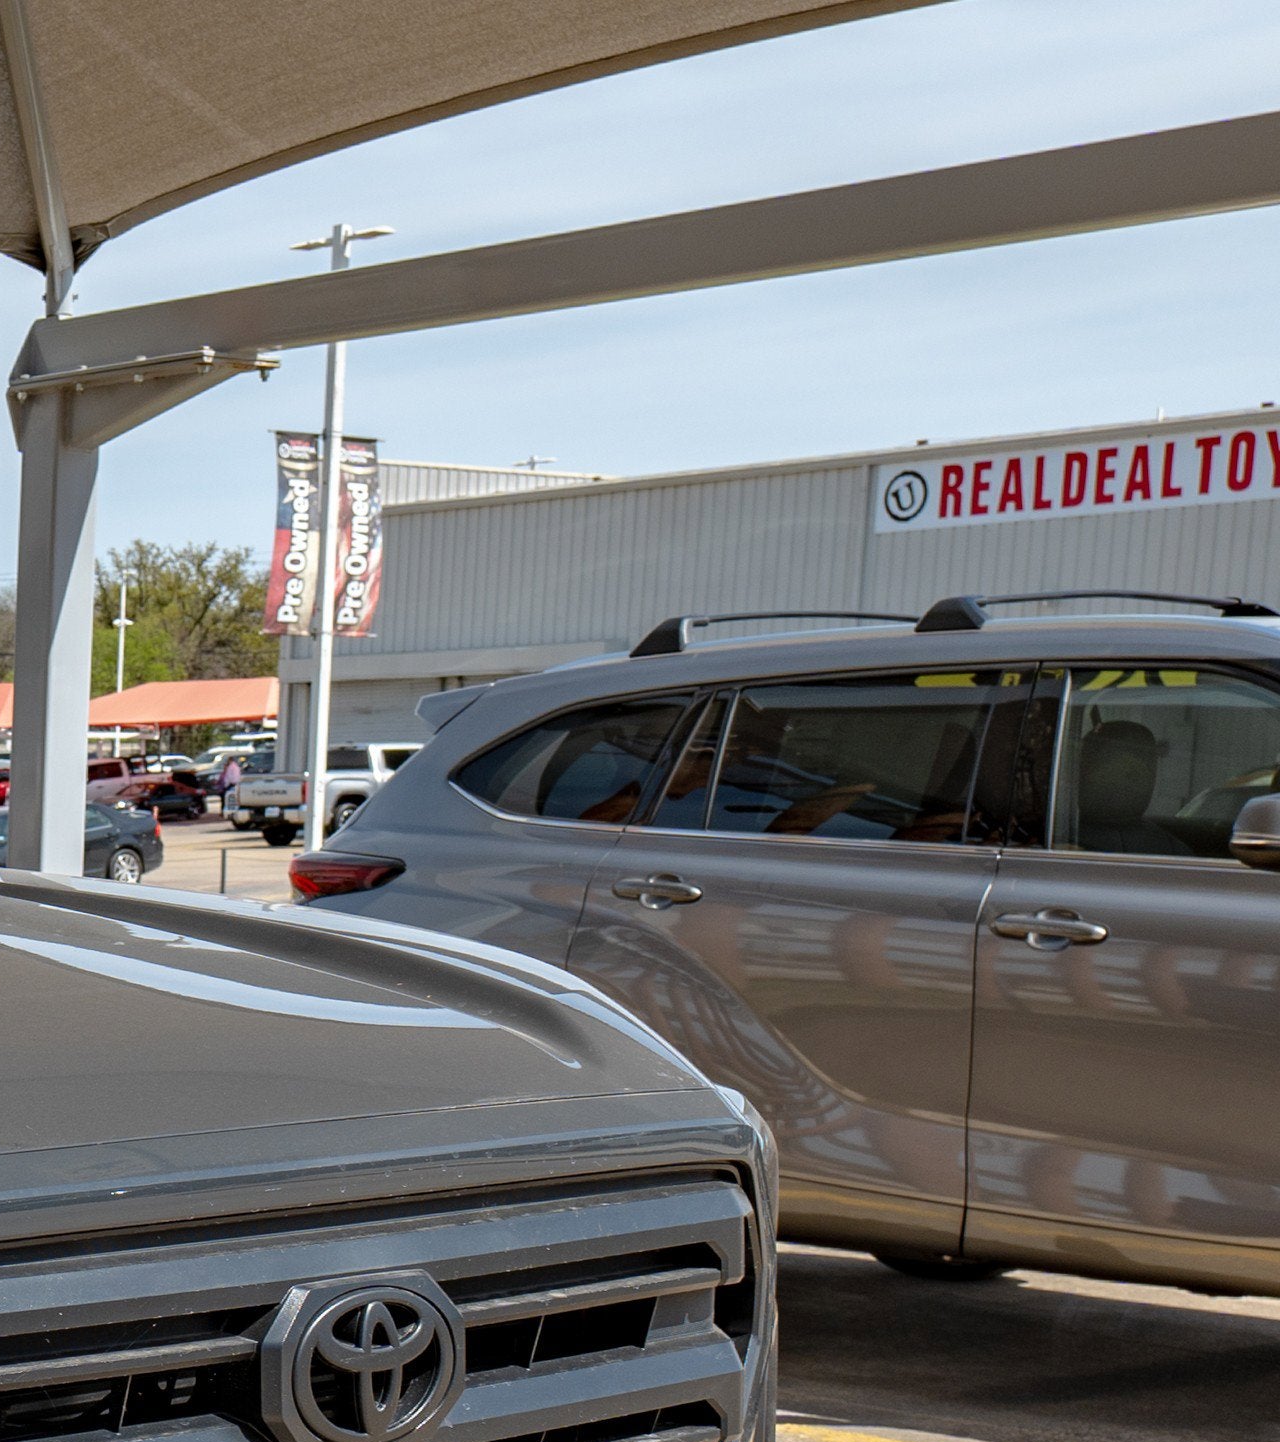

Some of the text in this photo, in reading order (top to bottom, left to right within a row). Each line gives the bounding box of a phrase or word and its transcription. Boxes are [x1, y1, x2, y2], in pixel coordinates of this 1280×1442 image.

[284, 478, 310, 573] Owned
[344, 482, 370, 576] Owned
[277, 577, 304, 623] Pre
[337, 580, 365, 625] Pre
